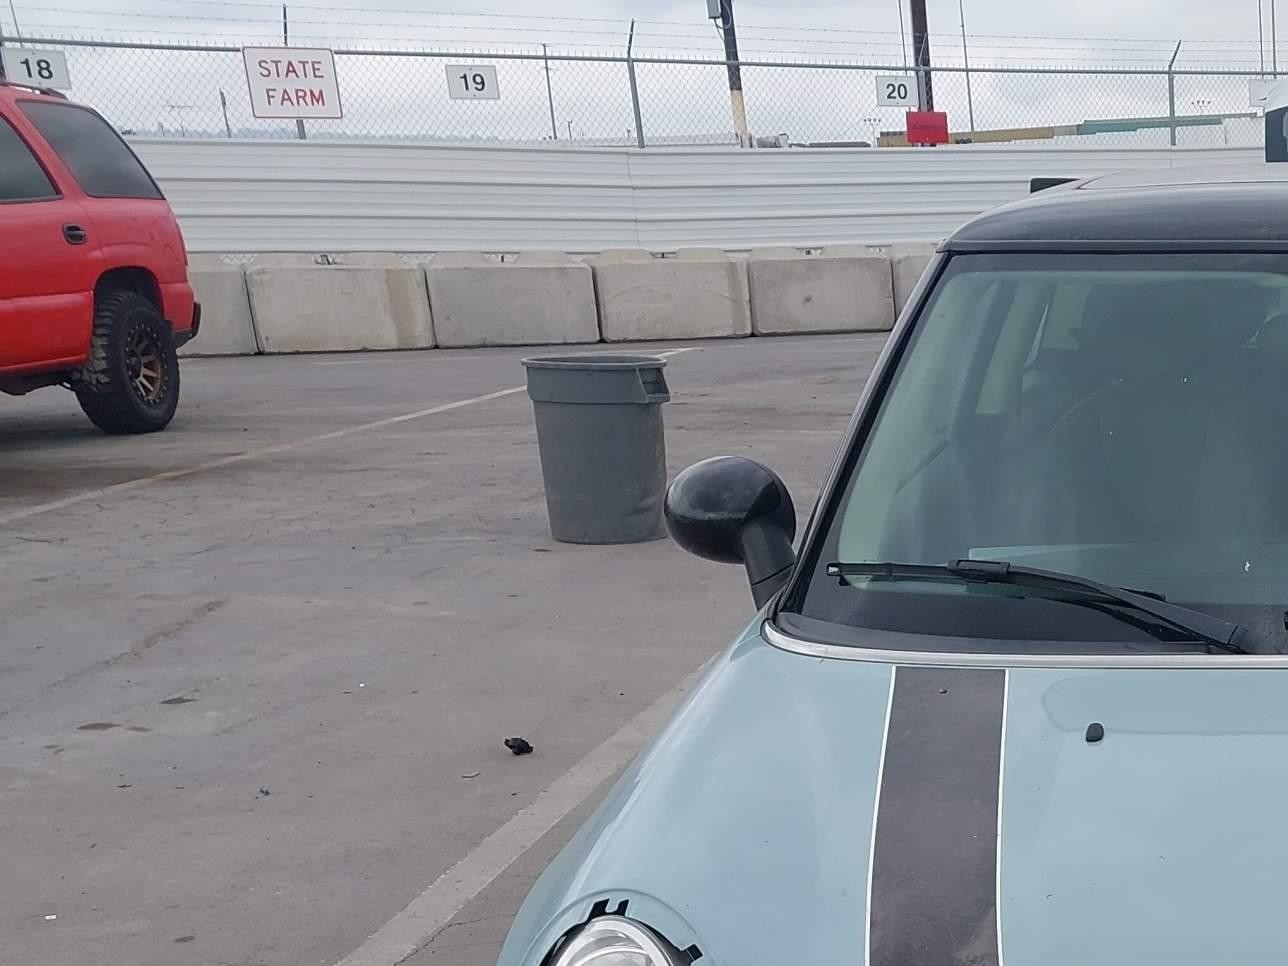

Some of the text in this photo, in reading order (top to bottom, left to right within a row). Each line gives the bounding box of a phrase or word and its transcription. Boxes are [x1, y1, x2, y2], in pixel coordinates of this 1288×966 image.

[20, 58, 54, 80] 18
[257, 59, 325, 79] STATE
[459, 72, 486, 92] 19
[886, 83, 908, 100] 20
[265, 87, 326, 107] FARM
